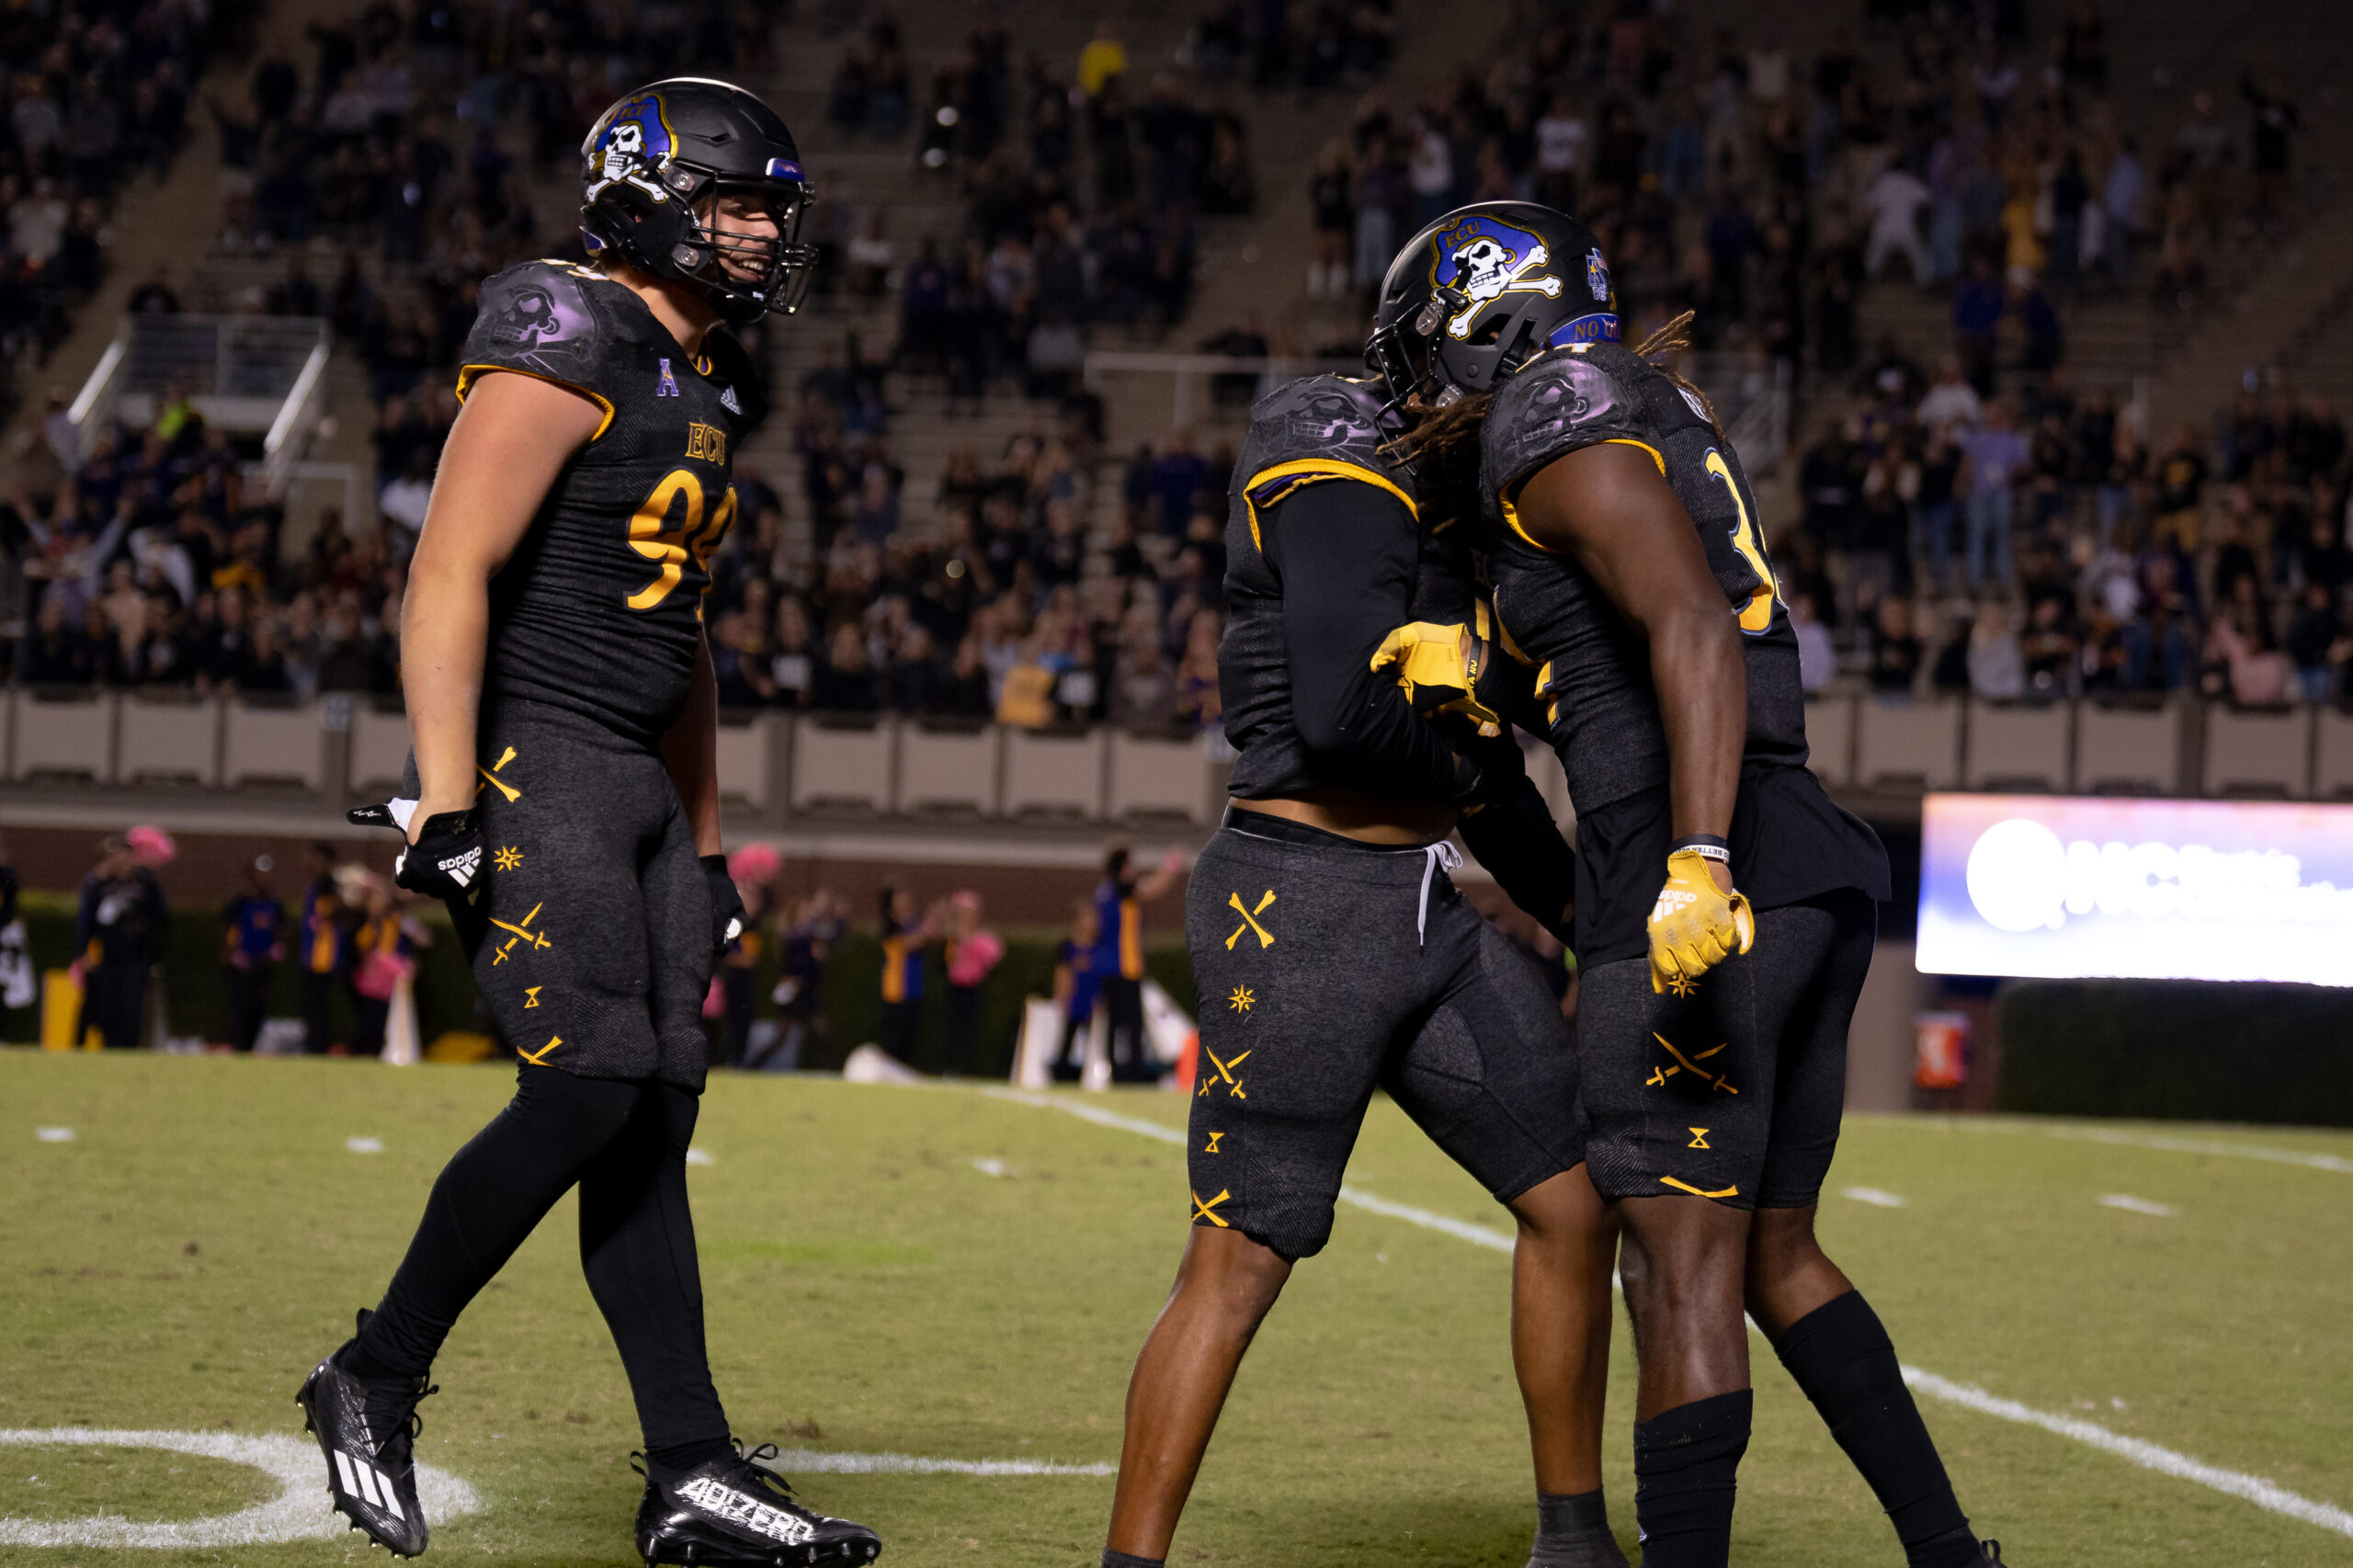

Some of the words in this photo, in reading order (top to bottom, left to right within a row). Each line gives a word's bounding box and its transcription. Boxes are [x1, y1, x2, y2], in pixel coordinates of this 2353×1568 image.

[1445, 221, 1480, 248] ECU
[1574, 321, 1599, 340] NO
[655, 358, 679, 397] A
[685, 421, 726, 467] ECU
[438, 846, 483, 871] adidas
